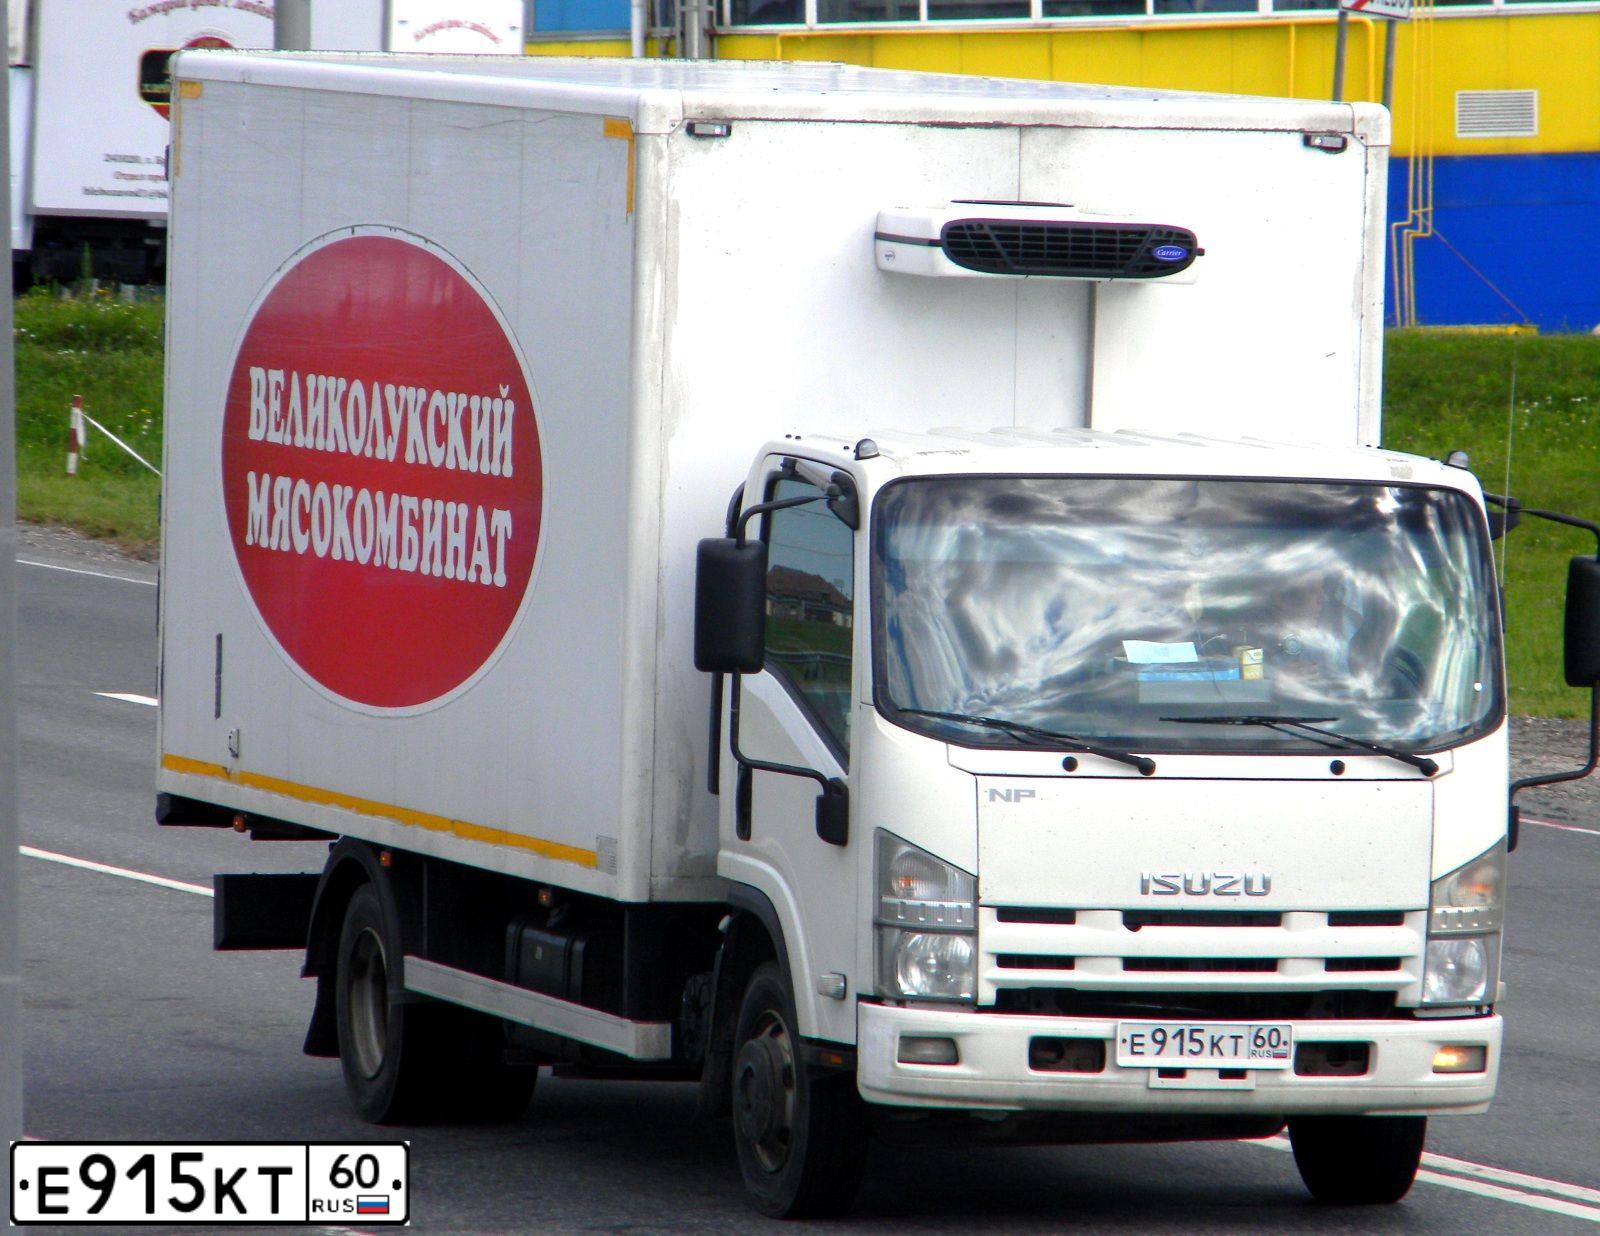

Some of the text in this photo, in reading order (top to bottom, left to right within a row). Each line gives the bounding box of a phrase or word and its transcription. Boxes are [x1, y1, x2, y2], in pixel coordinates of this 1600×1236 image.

[248, 366, 515, 478] ВЕЛИКОЛУКСКИЙ
[245, 471, 513, 588] МЯСОКОМБИНАТ
[988, 788, 1036, 803] NP
[1140, 871, 1272, 896] ISUZU
[1252, 1027, 1282, 1048] 60
[1251, 1049, 1272, 1058] RUS
